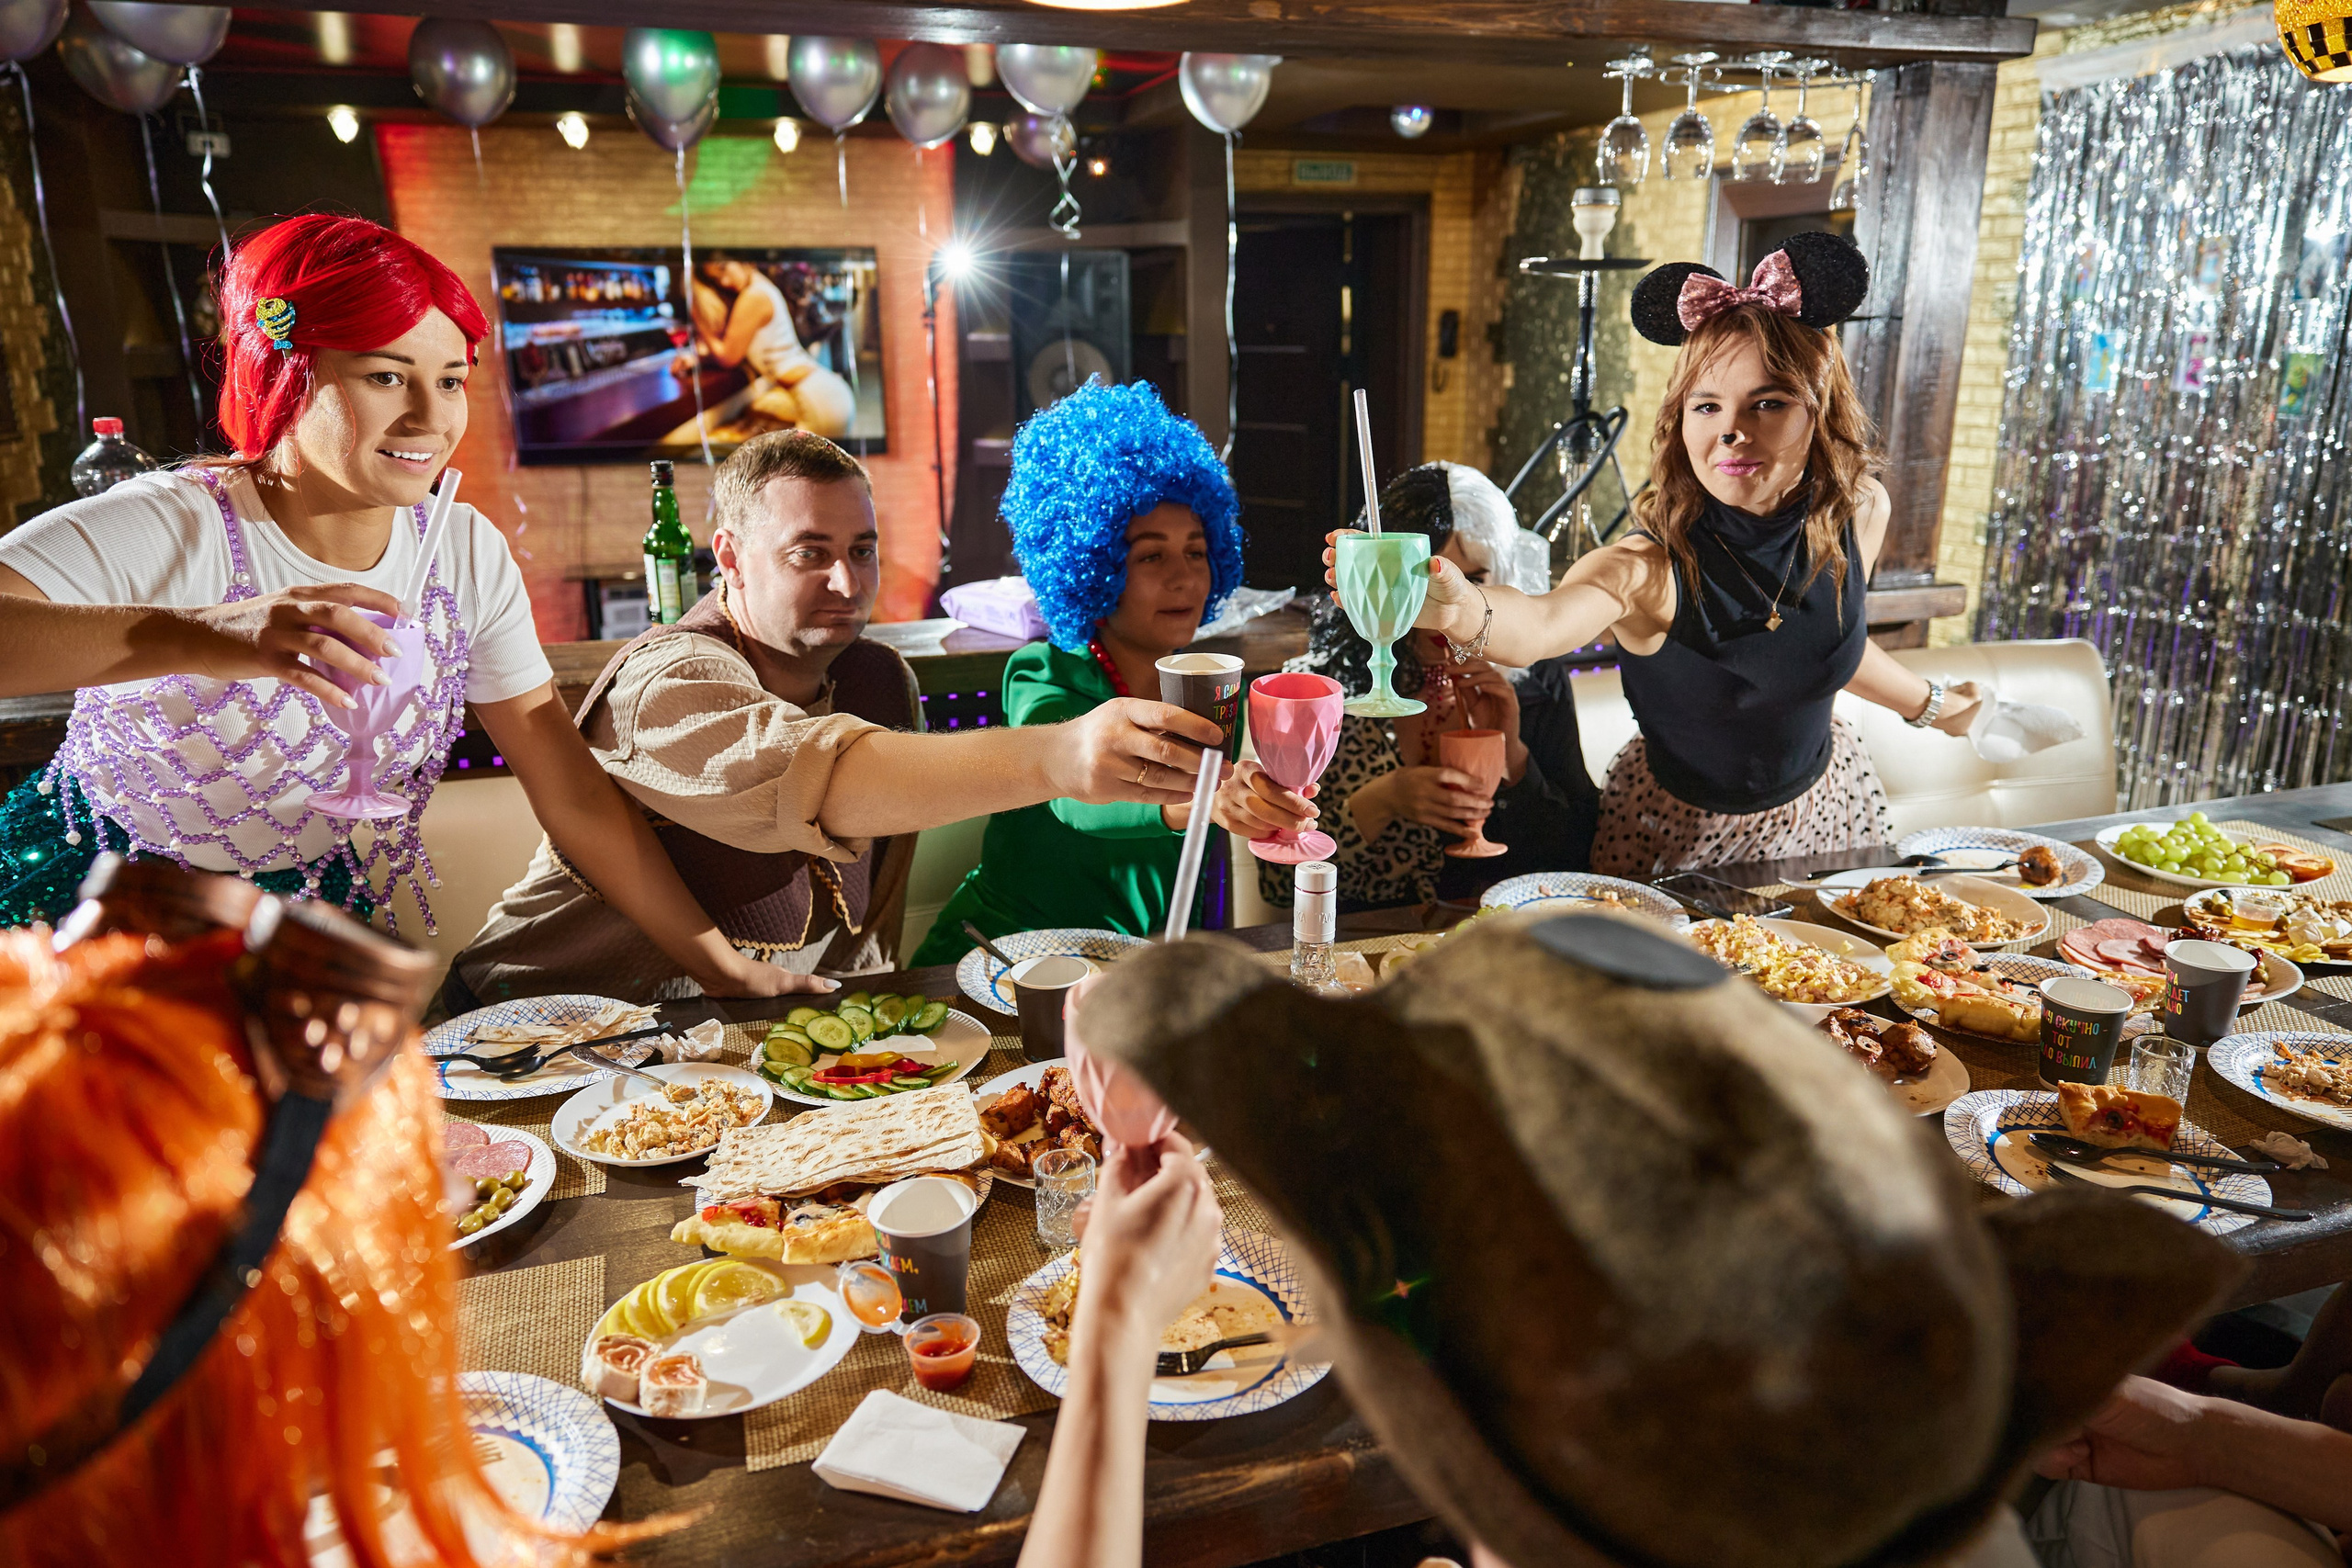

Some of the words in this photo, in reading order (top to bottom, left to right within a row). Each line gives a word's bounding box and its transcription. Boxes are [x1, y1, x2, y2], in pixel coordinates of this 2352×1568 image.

[1214, 685, 1221, 702] Я
[2055, 1015, 2100, 1036] СКУЧНО
[2052, 1030, 2073, 1049] ТОТ
[2055, 1050, 2097, 1069] ВЫПИЛ
